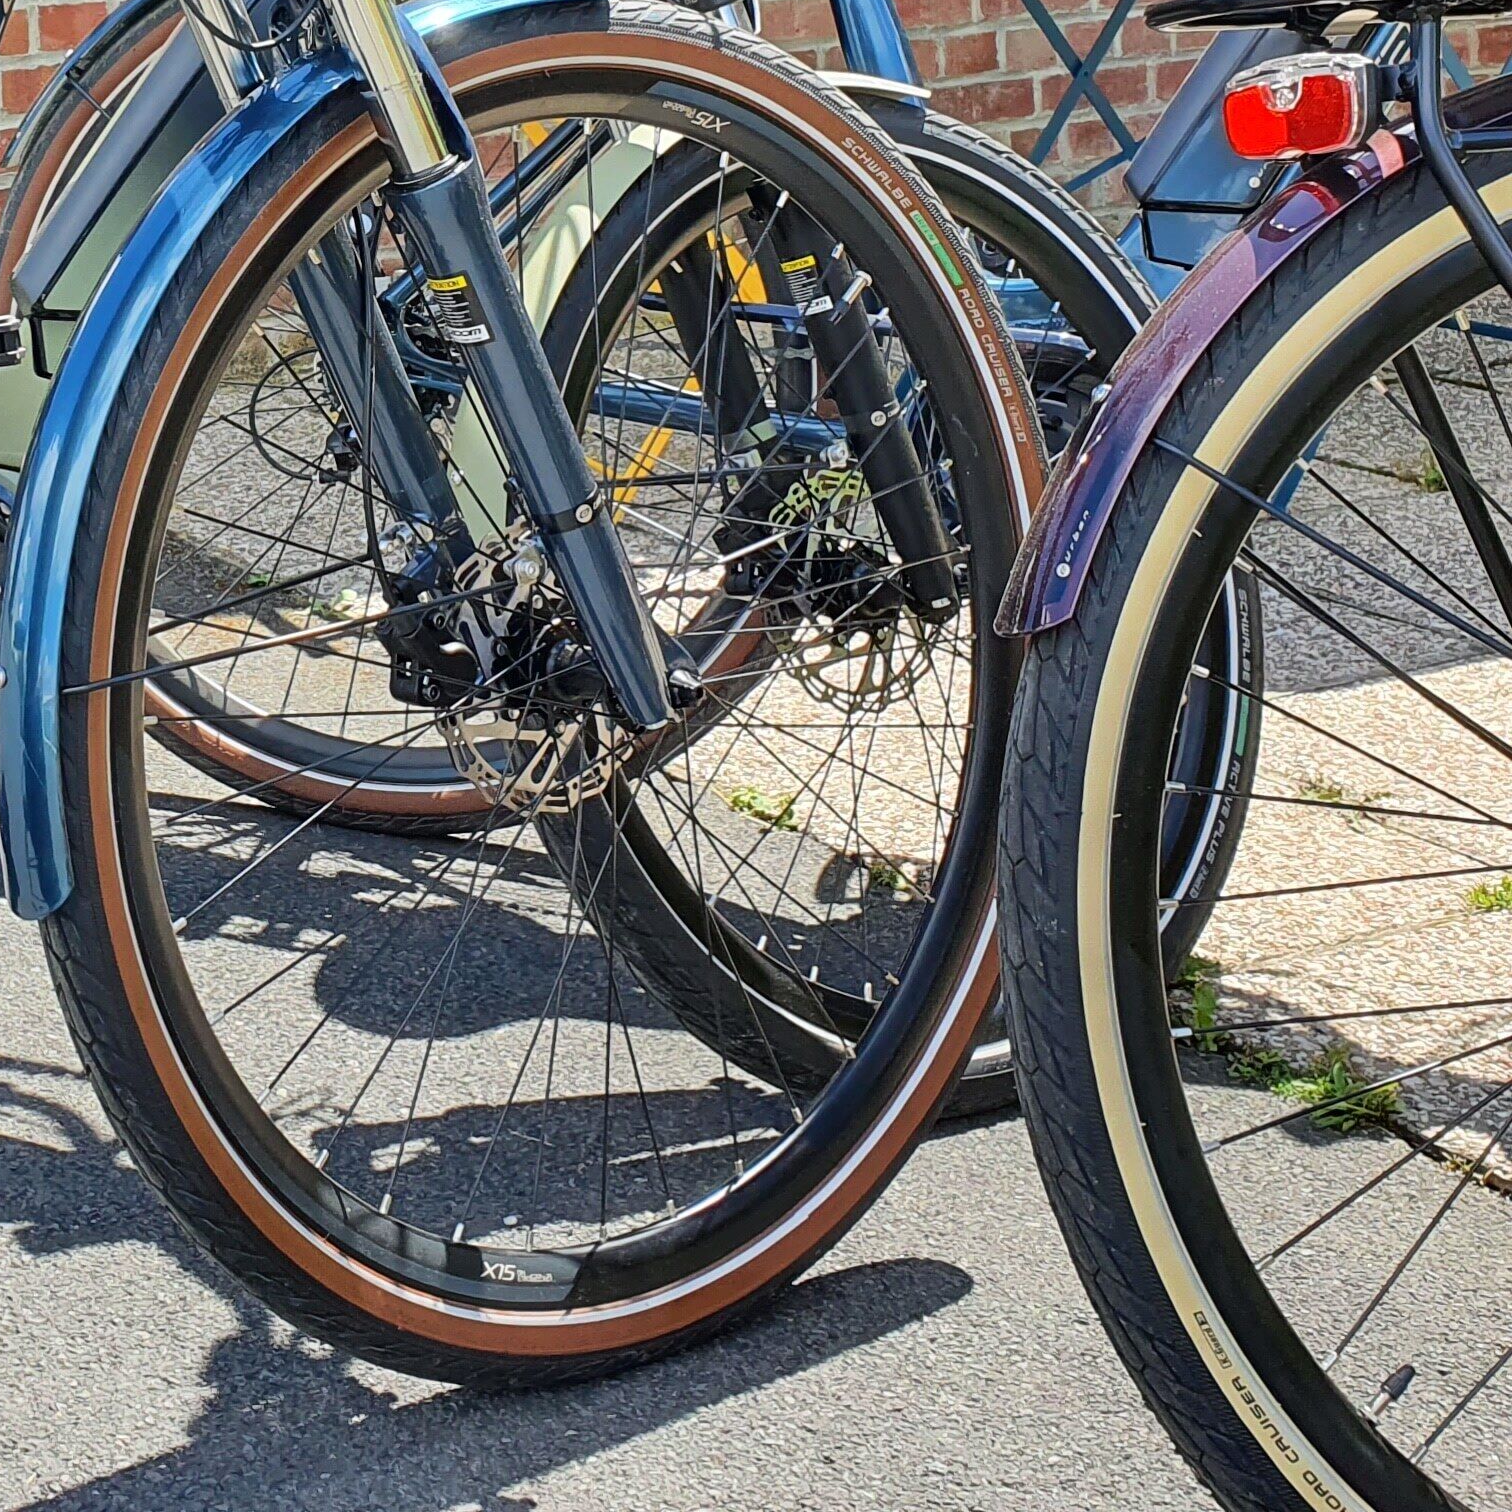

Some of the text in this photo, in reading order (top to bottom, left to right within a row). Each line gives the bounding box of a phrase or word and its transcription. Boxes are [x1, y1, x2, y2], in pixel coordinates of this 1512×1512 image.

[691, 111, 731, 133] X15
[840, 136, 913, 217] SCHWALBE
[957, 288, 986, 330] ROAD
[980, 333, 1014, 400] CRUISER
[1237, 587, 1252, 685] SCHWALBE
[1208, 818, 1227, 866] PLUS
[480, 1261, 516, 1281] X15
[1231, 1374, 1300, 1465] CRUISER
